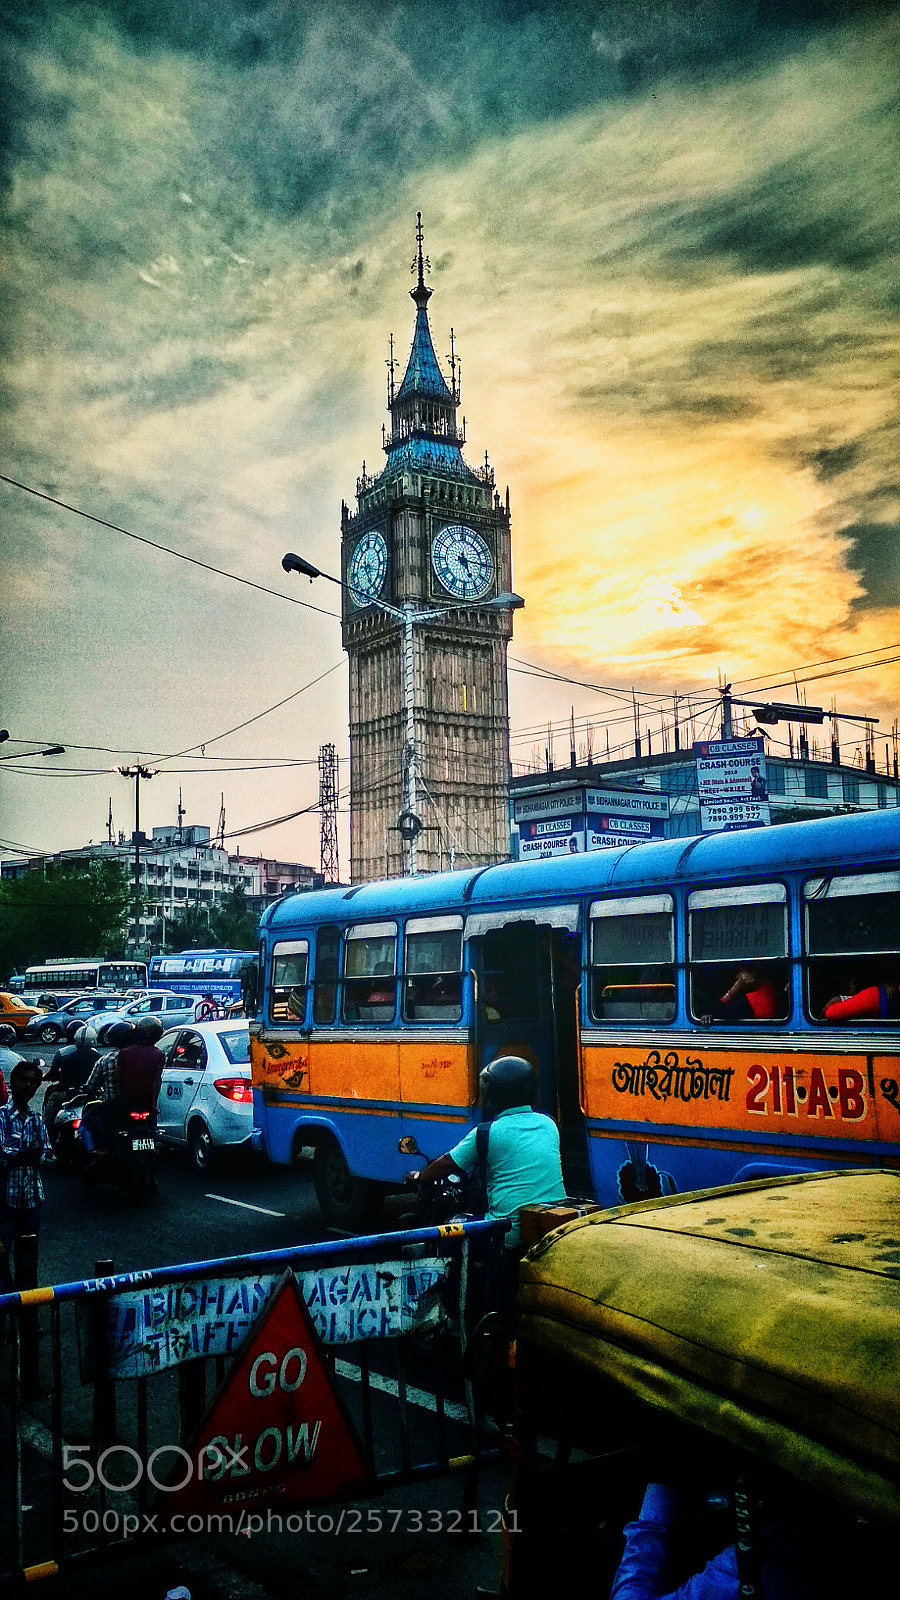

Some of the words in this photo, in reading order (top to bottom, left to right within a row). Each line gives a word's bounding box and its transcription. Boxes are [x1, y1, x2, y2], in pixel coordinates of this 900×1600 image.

[710, 745, 720, 753] CB
[722, 742, 756, 751] CLASSES
[700, 760, 727, 770] CRASH
[729, 758, 761, 767] COURSE
[559, 796, 575, 808] POLICE
[597, 796, 631, 808] BIDHANNAGAR
[631, 800, 643, 809] CITY
[643, 801, 660, 811] POLICE
[728, 806, 743, 814] 999
[745, 812, 761, 820] 777
[545, 820, 571, 832] CLASSES
[609, 819, 619, 828] CB
[620, 820, 650, 832] CLASSES
[523, 842, 542, 853] CRASH
[543, 838, 568, 850] COURSE
[591, 836, 616, 846] CRASH
[249, 1346, 308, 1399] GO
[203, 1420, 323, 1482] SLOW
